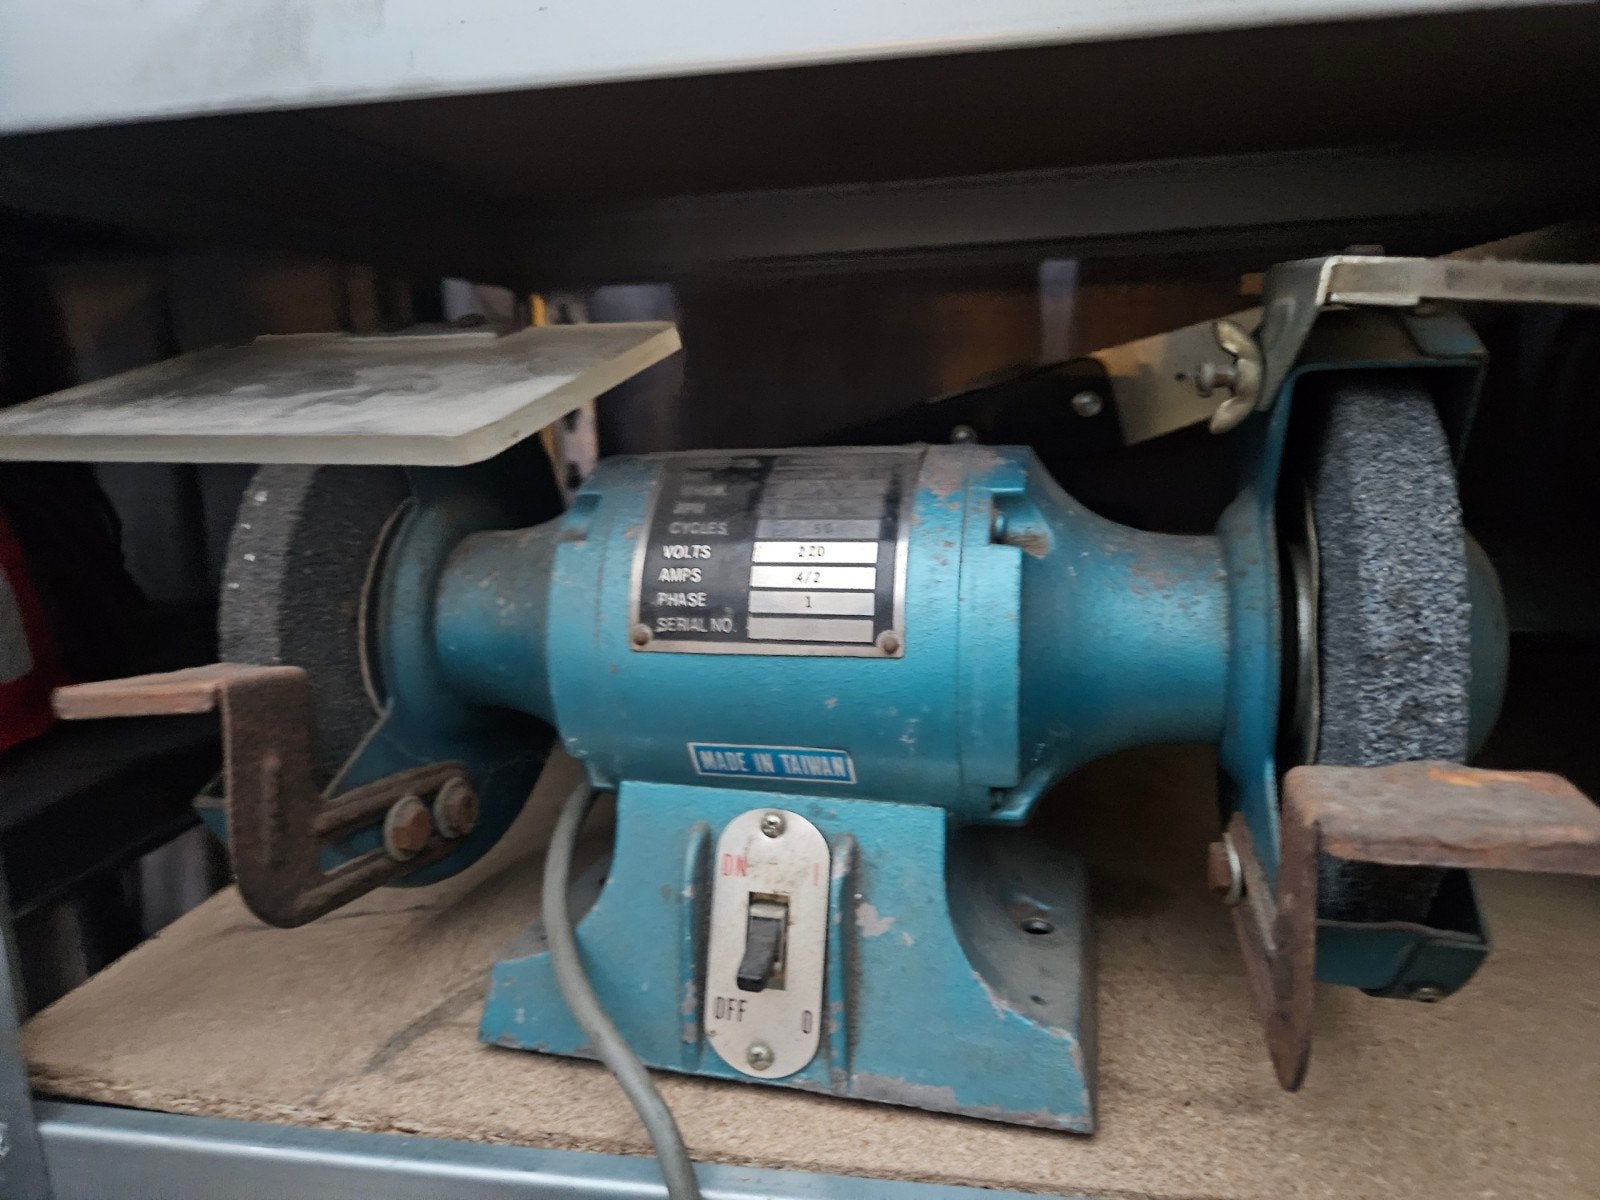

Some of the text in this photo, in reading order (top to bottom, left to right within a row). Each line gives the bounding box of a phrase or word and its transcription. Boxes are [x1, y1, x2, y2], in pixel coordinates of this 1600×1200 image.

[669, 522, 729, 535] CYCLES
[663, 544, 825, 560] VOLTS 220
[657, 567, 821, 584] AMPS 4/2
[656, 591, 813, 608] PHASE 1
[655, 616, 708, 633] SERIAL
[700, 751, 847, 777] MADE IN TAIWAN
[720, 852, 749, 877] ON
[713, 996, 748, 1022] OFF
